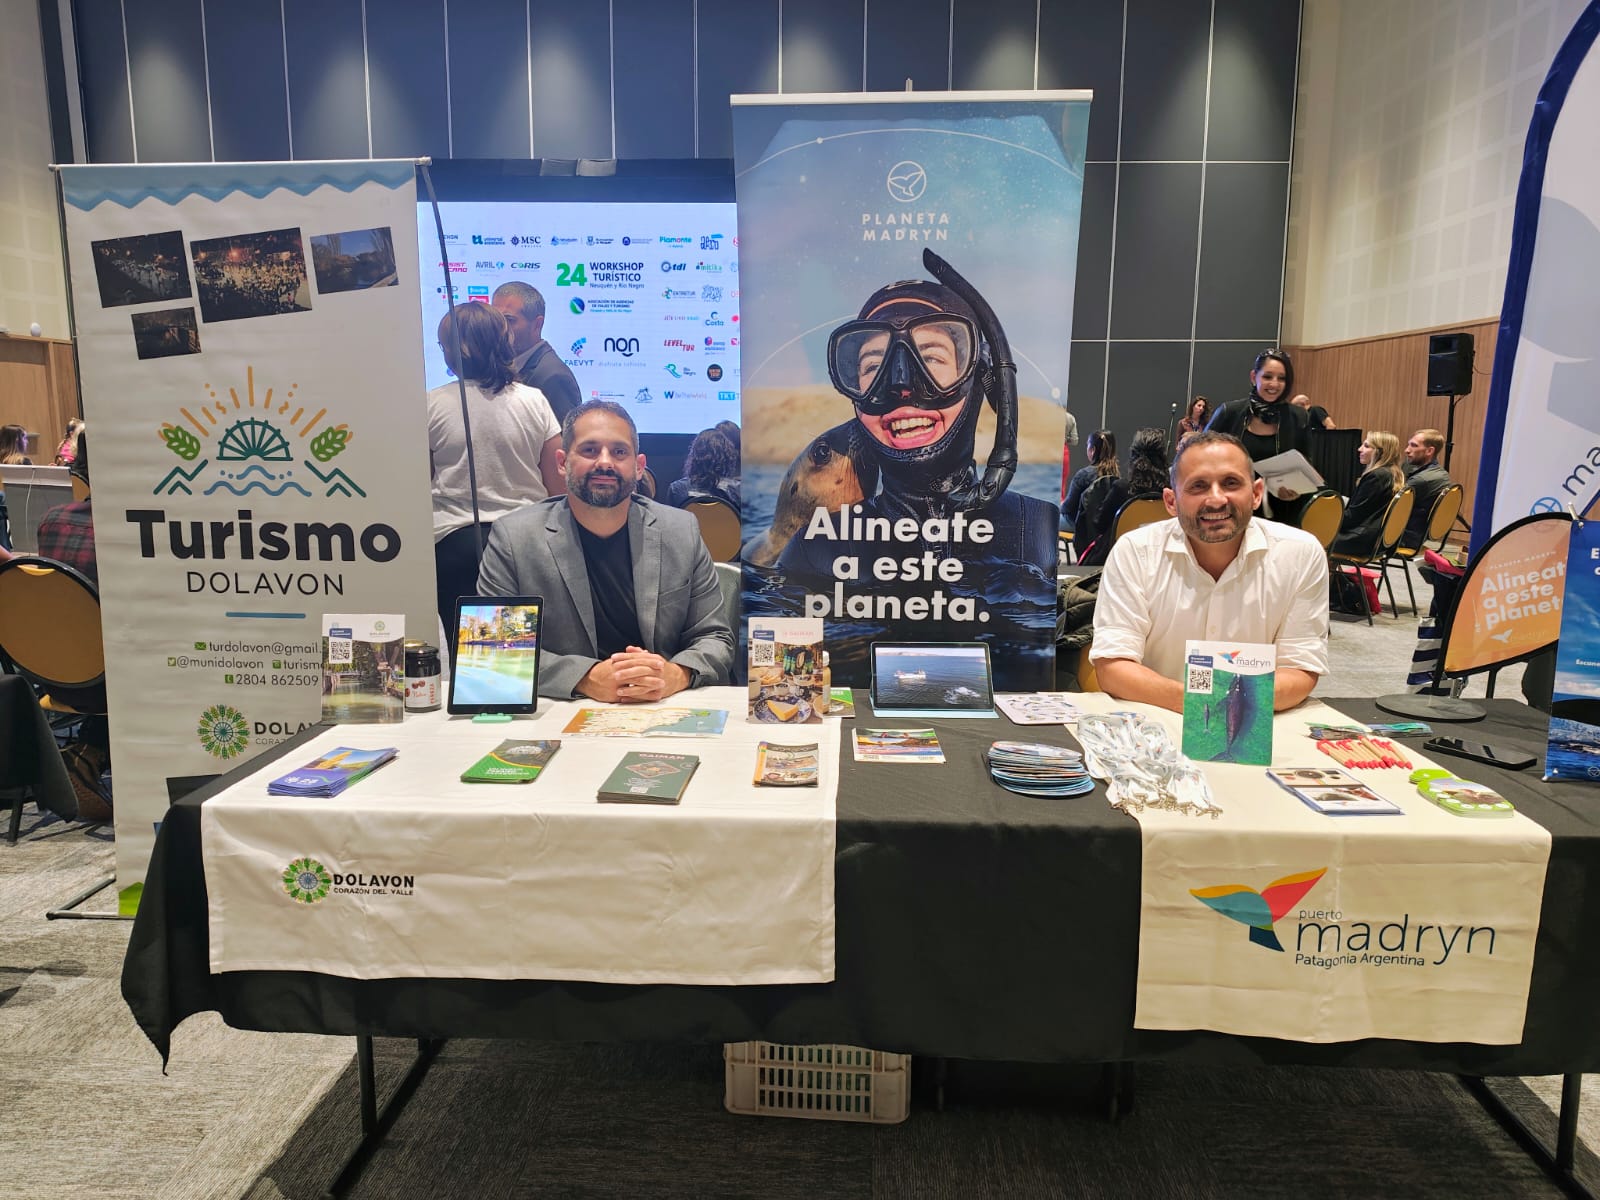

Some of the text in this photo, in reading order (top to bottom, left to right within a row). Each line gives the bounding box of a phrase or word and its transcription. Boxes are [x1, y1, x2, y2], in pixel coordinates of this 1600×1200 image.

[862, 213, 949, 225] PLANETA
[521, 236, 541, 244] MSC
[863, 229, 948, 241] MADRYN
[590, 262, 644, 271] WORKSHOP
[556, 263, 587, 286] 24
[593, 271, 641, 281] TURÍSTICO
[664, 339, 683, 347] LEVEL
[804, 504, 995, 544] Alineate
[125, 509, 402, 563] Turismo
[832, 551, 964, 582] a este
[187, 571, 344, 595] DOLAVON
[1480, 561, 1566, 595] Alineat
[805, 582, 991, 623] planeta.
[1483, 584, 1554, 609] a este
[1485, 596, 1561, 631] planet
[209, 641, 322, 656] turdolavon@gmail.
[177, 656, 264, 669] @munidolavon
[1236, 657, 1271, 667] madryn
[236, 674, 319, 686] 2804 862509
[254, 722, 314, 736] DOLA
[333, 873, 414, 888] DOLAVON
[1299, 908, 1342, 921] puerto
[1296, 913, 1496, 965] madryn
[1295, 953, 1425, 968] Patagonia Argentina
